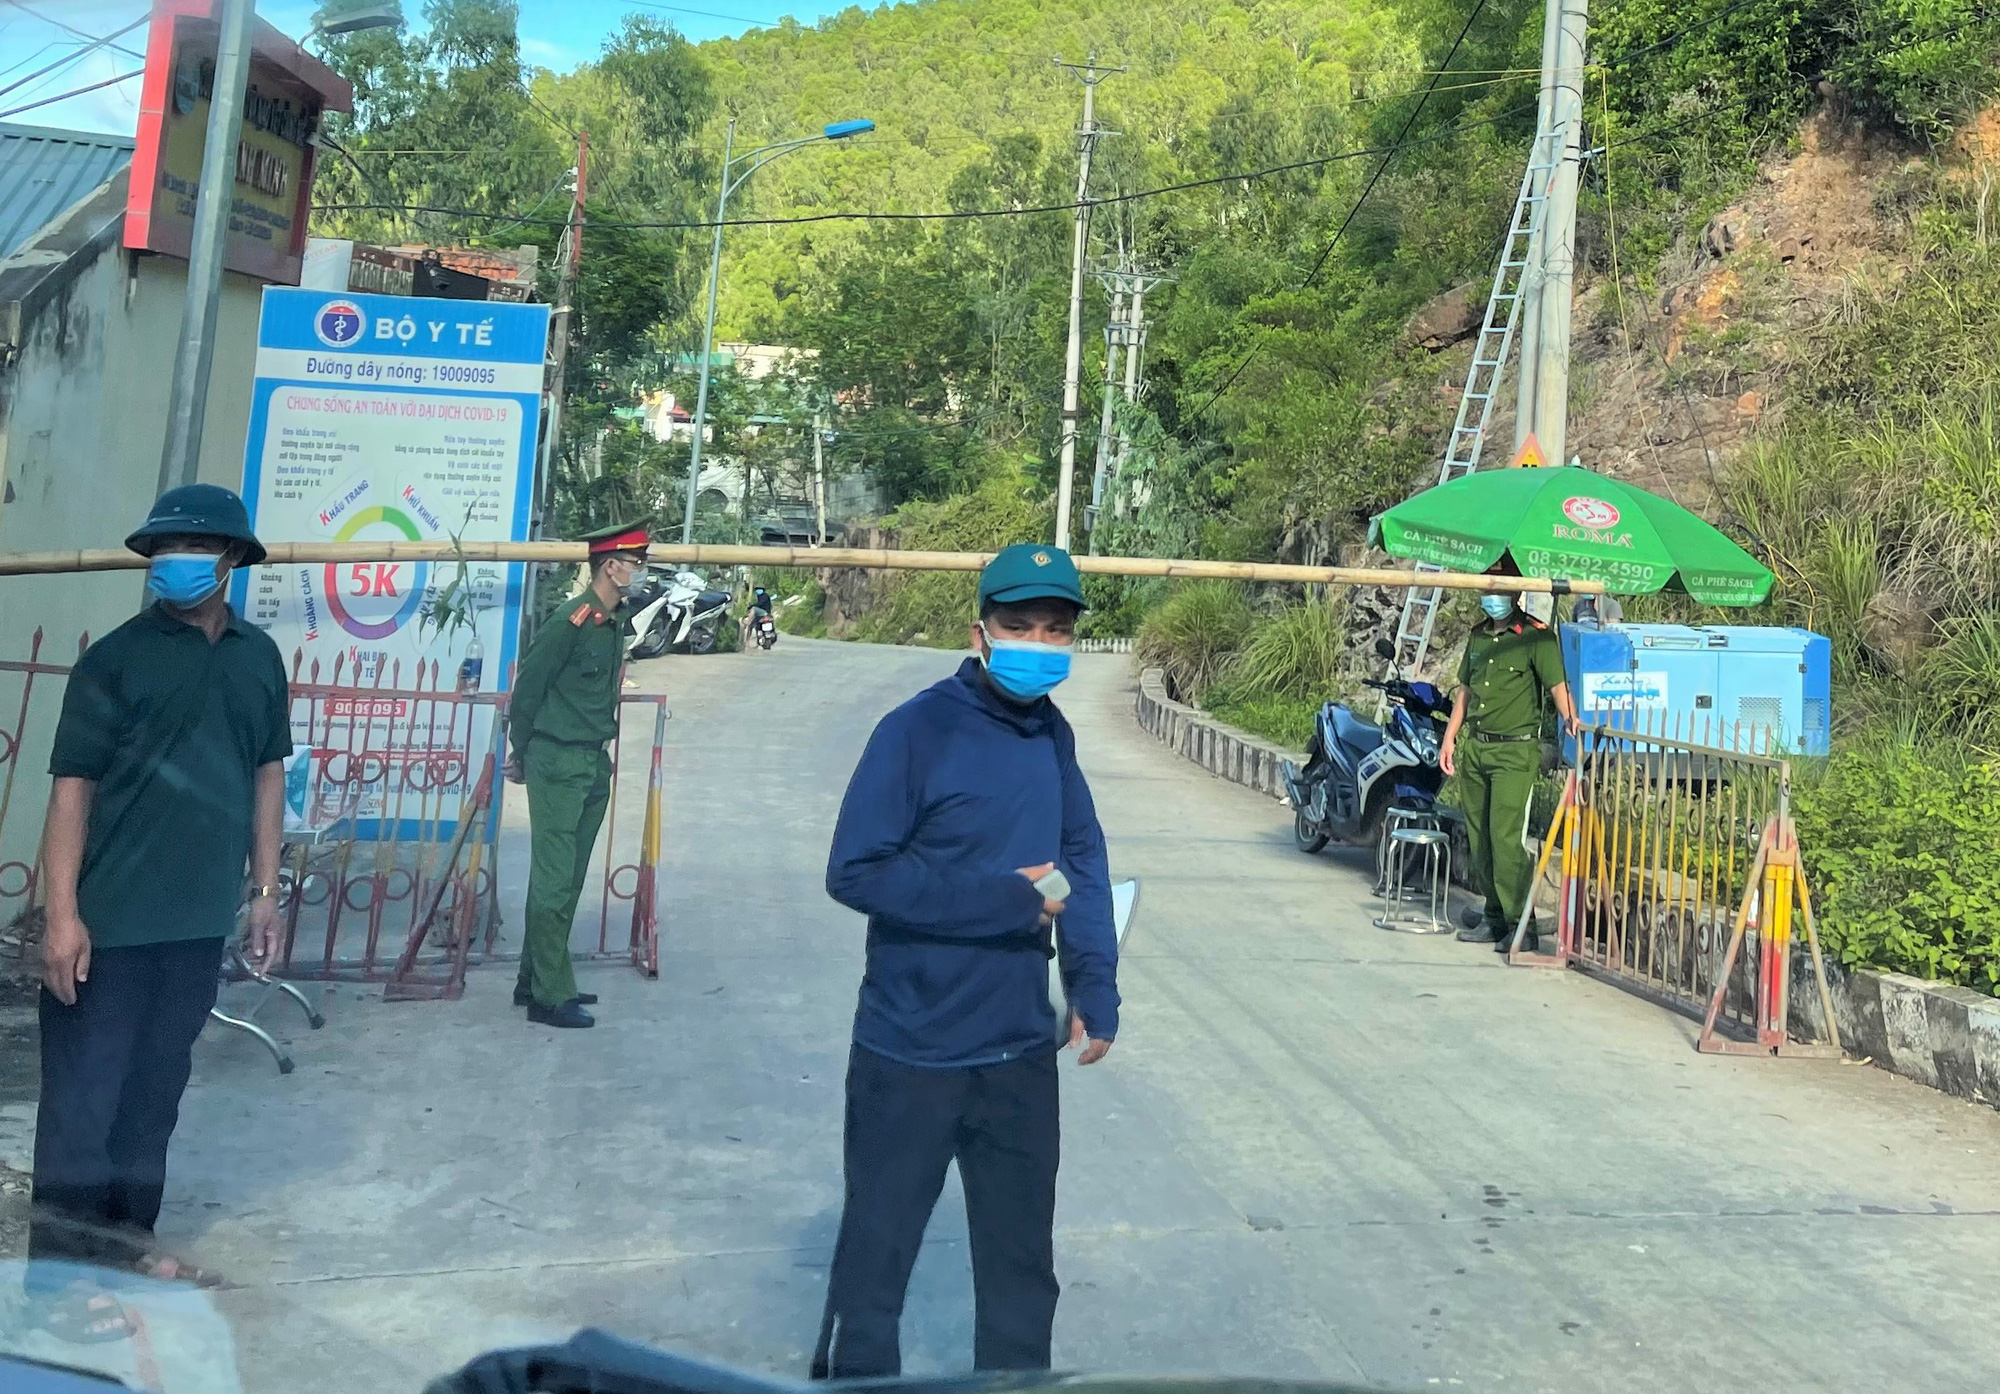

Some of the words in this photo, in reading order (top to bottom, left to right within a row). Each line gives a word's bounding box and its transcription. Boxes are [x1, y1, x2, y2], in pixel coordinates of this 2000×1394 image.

[375, 314, 416, 347] BỘ
[428, 321, 446, 343] Y
[456, 317, 494, 346] TẾ
[306, 357, 352, 379] Đường
[357, 360, 382, 381] dây
[387, 362, 427, 383] nóng:
[433, 365, 495, 384] 19009095
[324, 393, 350, 414] SỐNG
[353, 400, 368, 415] AN
[371, 398, 397, 416] TOÀN
[400, 400, 416, 417] VỚI
[418, 404, 436, 421] ĐẠI
[438, 406, 461, 422] DỊCH
[463, 406, 507, 422] COVID-19
[344, 480, 369, 505] TRANG
[1403, 529, 1420, 542] CÀ
[1450, 539, 1483, 555] SẠCH
[1528, 550, 1654, 580] 08.3792.4590
[350, 563, 400, 597] 5K
[1691, 575, 1704, 586] CÀ
[1727, 578, 1754, 589] SẠCH
[372, 651, 388, 661] BO
